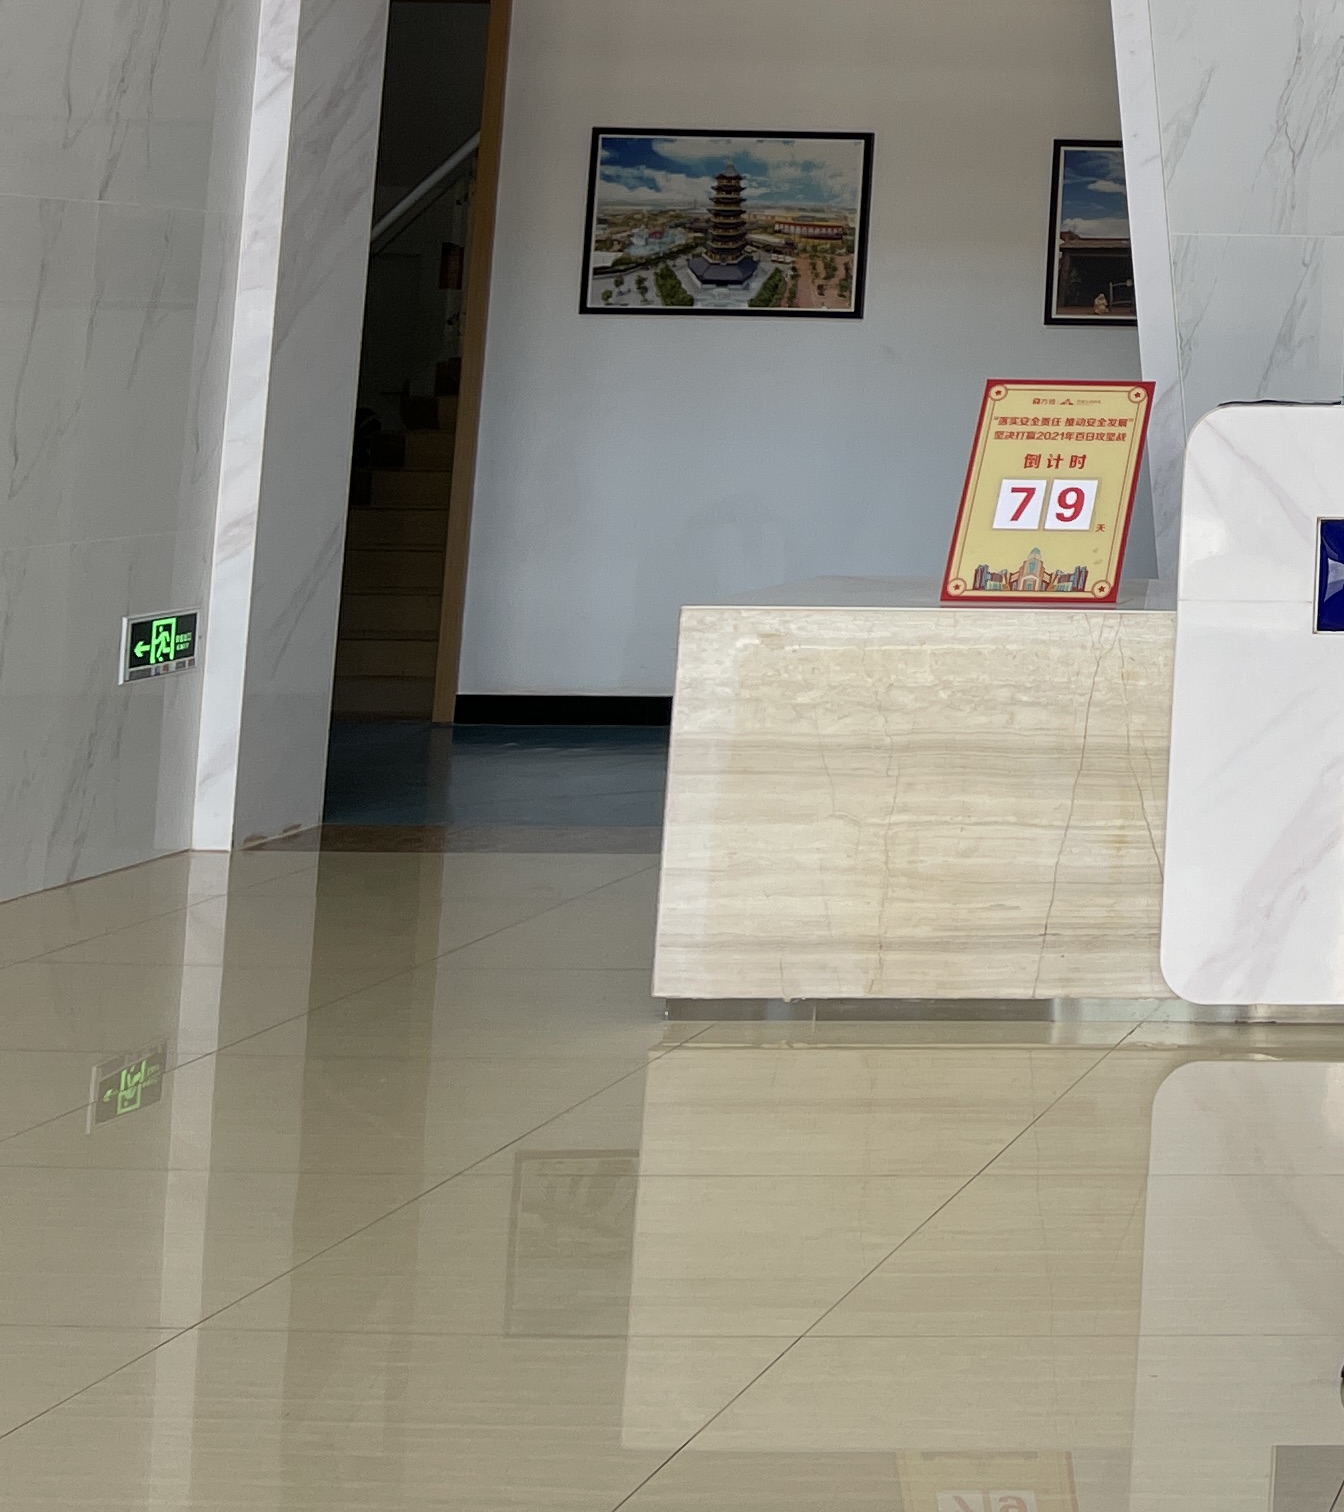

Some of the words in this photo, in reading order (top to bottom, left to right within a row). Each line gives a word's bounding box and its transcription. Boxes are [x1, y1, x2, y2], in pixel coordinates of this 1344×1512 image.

[1024, 454, 1087, 469] 倒计时
[1009, 487, 1085, 522] 79
[1096, 524, 1106, 533] 天
